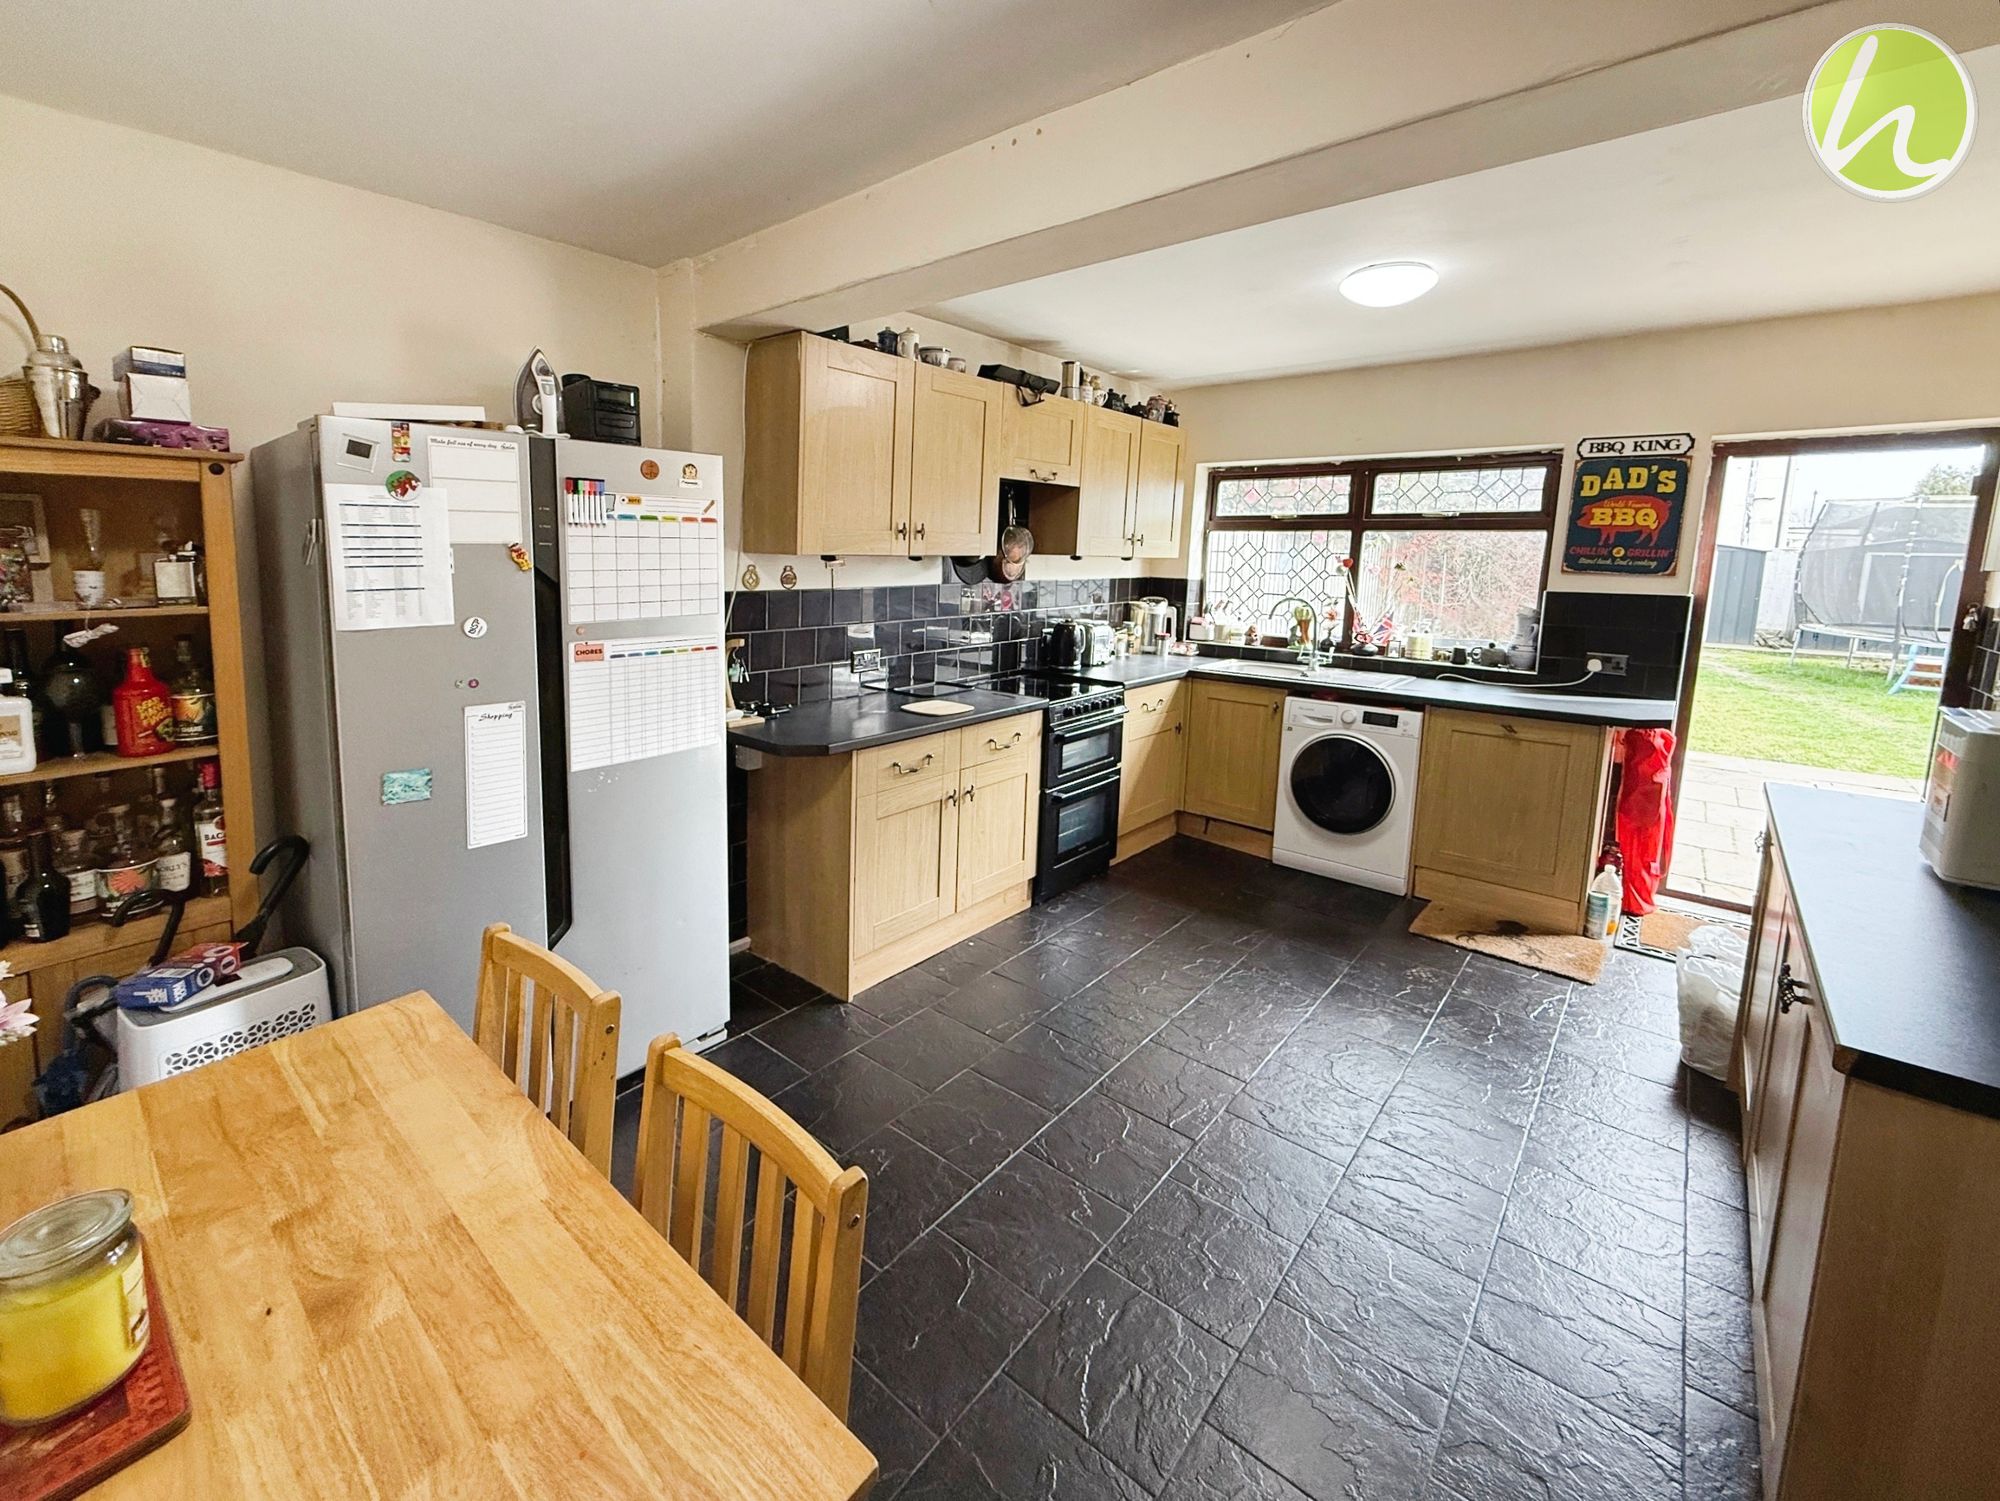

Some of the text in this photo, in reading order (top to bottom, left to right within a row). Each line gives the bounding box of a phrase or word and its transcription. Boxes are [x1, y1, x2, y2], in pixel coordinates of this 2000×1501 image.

[1588, 438, 1681, 454] BBQ KING
[1580, 465, 1677, 497] DAD'S
[1590, 508, 1660, 530] BBQ
[575, 648, 603, 656] CHORES
[478, 712, 513, 721] Shopping
